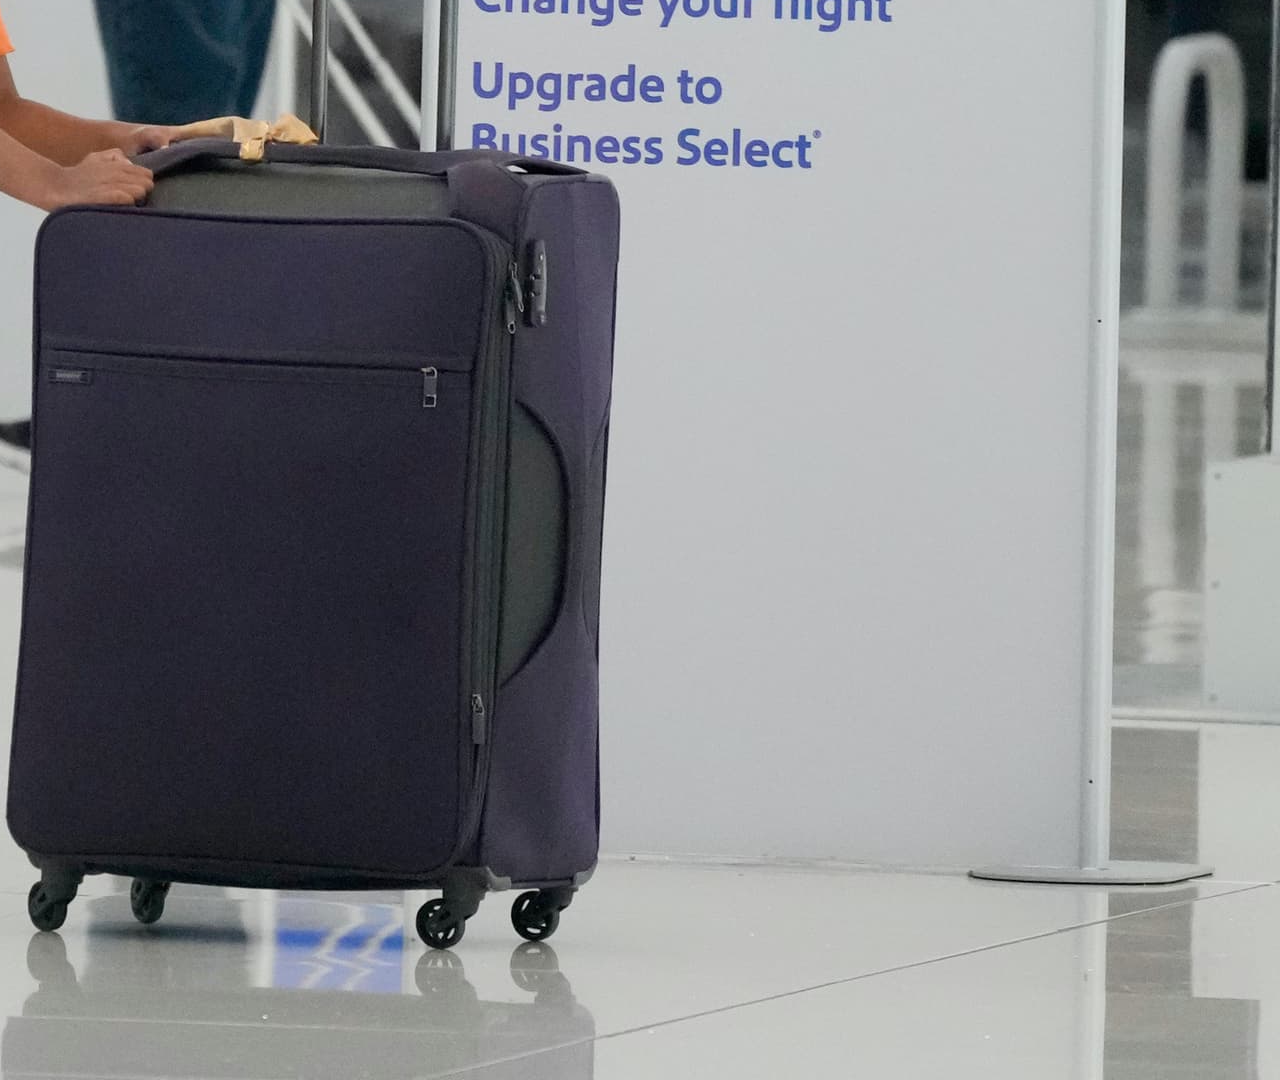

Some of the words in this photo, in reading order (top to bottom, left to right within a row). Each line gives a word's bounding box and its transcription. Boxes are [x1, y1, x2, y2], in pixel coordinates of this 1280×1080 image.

[471, 61, 665, 111] Upgrade
[677, 69, 722, 105] to
[471, 123, 663, 166] Business
